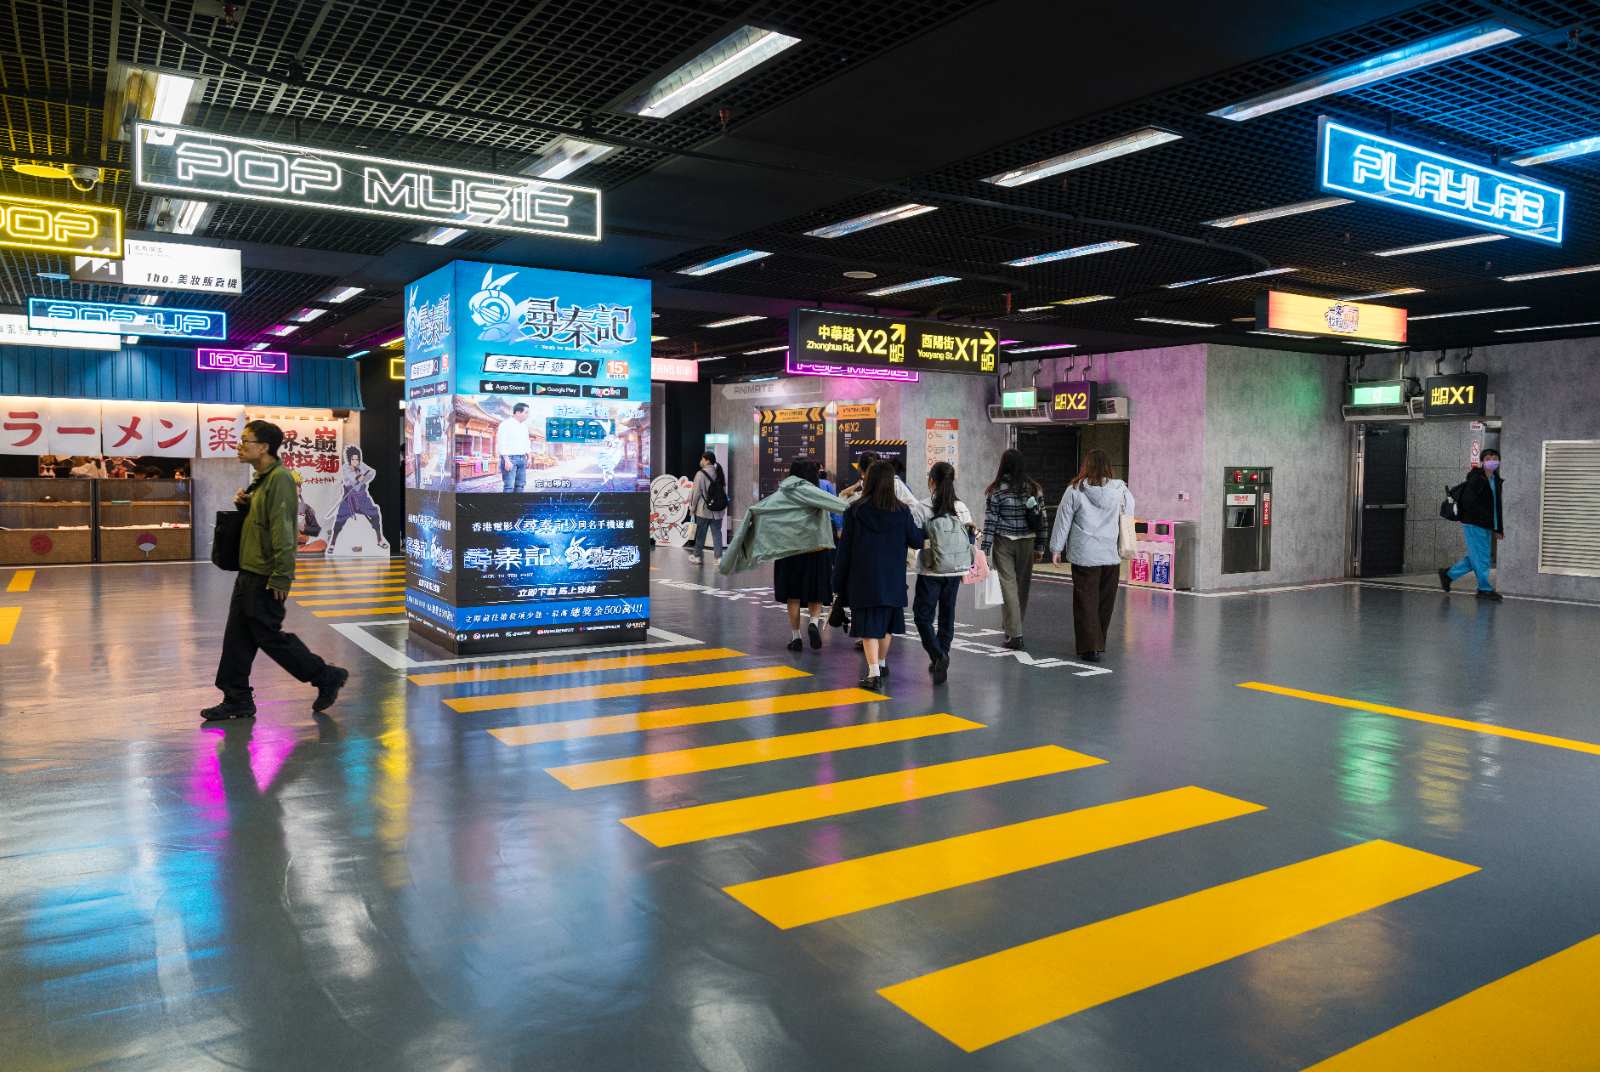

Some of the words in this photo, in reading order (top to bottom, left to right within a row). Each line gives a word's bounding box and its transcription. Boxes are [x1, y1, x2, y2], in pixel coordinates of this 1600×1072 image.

[176, 142, 343, 194] POP
[364, 167, 574, 227] MUSIC
[1353, 143, 1545, 228] PLAYLAB
[0, 205, 98, 242] OP
[48, 305, 211, 334] POP-UP
[522, 296, 637, 349] 尋秦記
[806, 340, 840, 352] Zhonghua
[841, 343, 855, 353] Rd.
[818, 324, 855, 341] 中華路
[856, 328, 888, 355] X2
[955, 337, 978, 362] X1
[209, 352, 276, 369] IDOL
[917, 349, 945, 361] Youyang
[945, 352, 955, 361] St.
[495, 383, 509, 392] App
[547, 386, 566, 395] Google
[566, 387, 577, 395] Play
[1449, 385, 1475, 405] X1
[1067, 392, 1087, 410] X2
[3, 411, 189, 449] ラーメン
